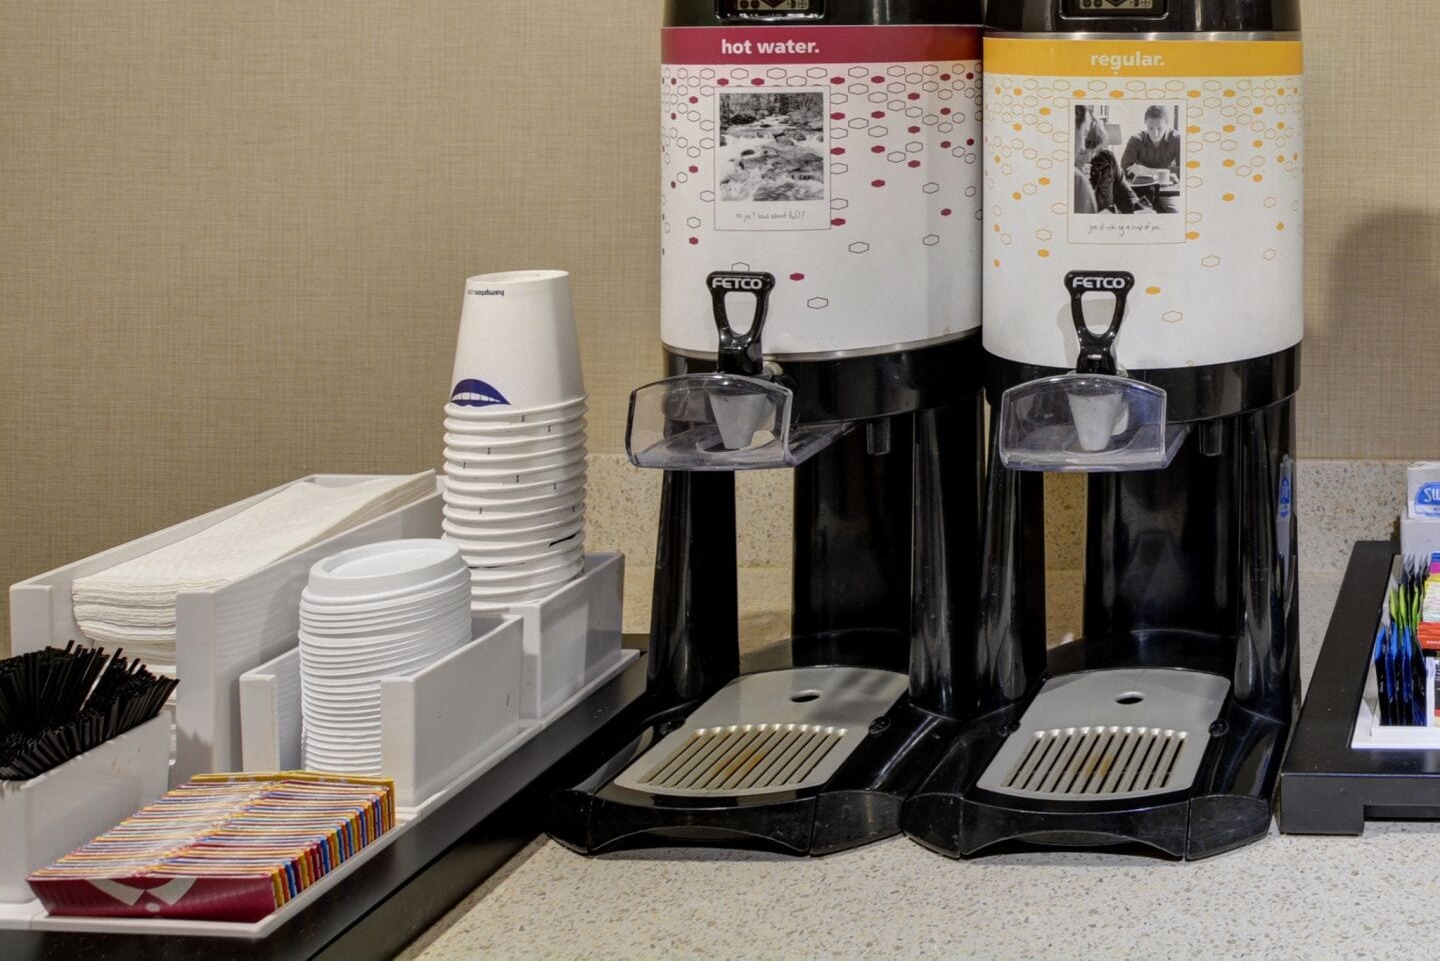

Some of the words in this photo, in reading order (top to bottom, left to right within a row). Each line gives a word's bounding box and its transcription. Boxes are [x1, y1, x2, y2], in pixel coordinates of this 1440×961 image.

[721, 38, 752, 55] hot
[757, 39, 820, 54] water.
[1090, 50, 1165, 70] regular.
[712, 277, 763, 290] FETCO
[1072, 276, 1126, 289] FETCO
